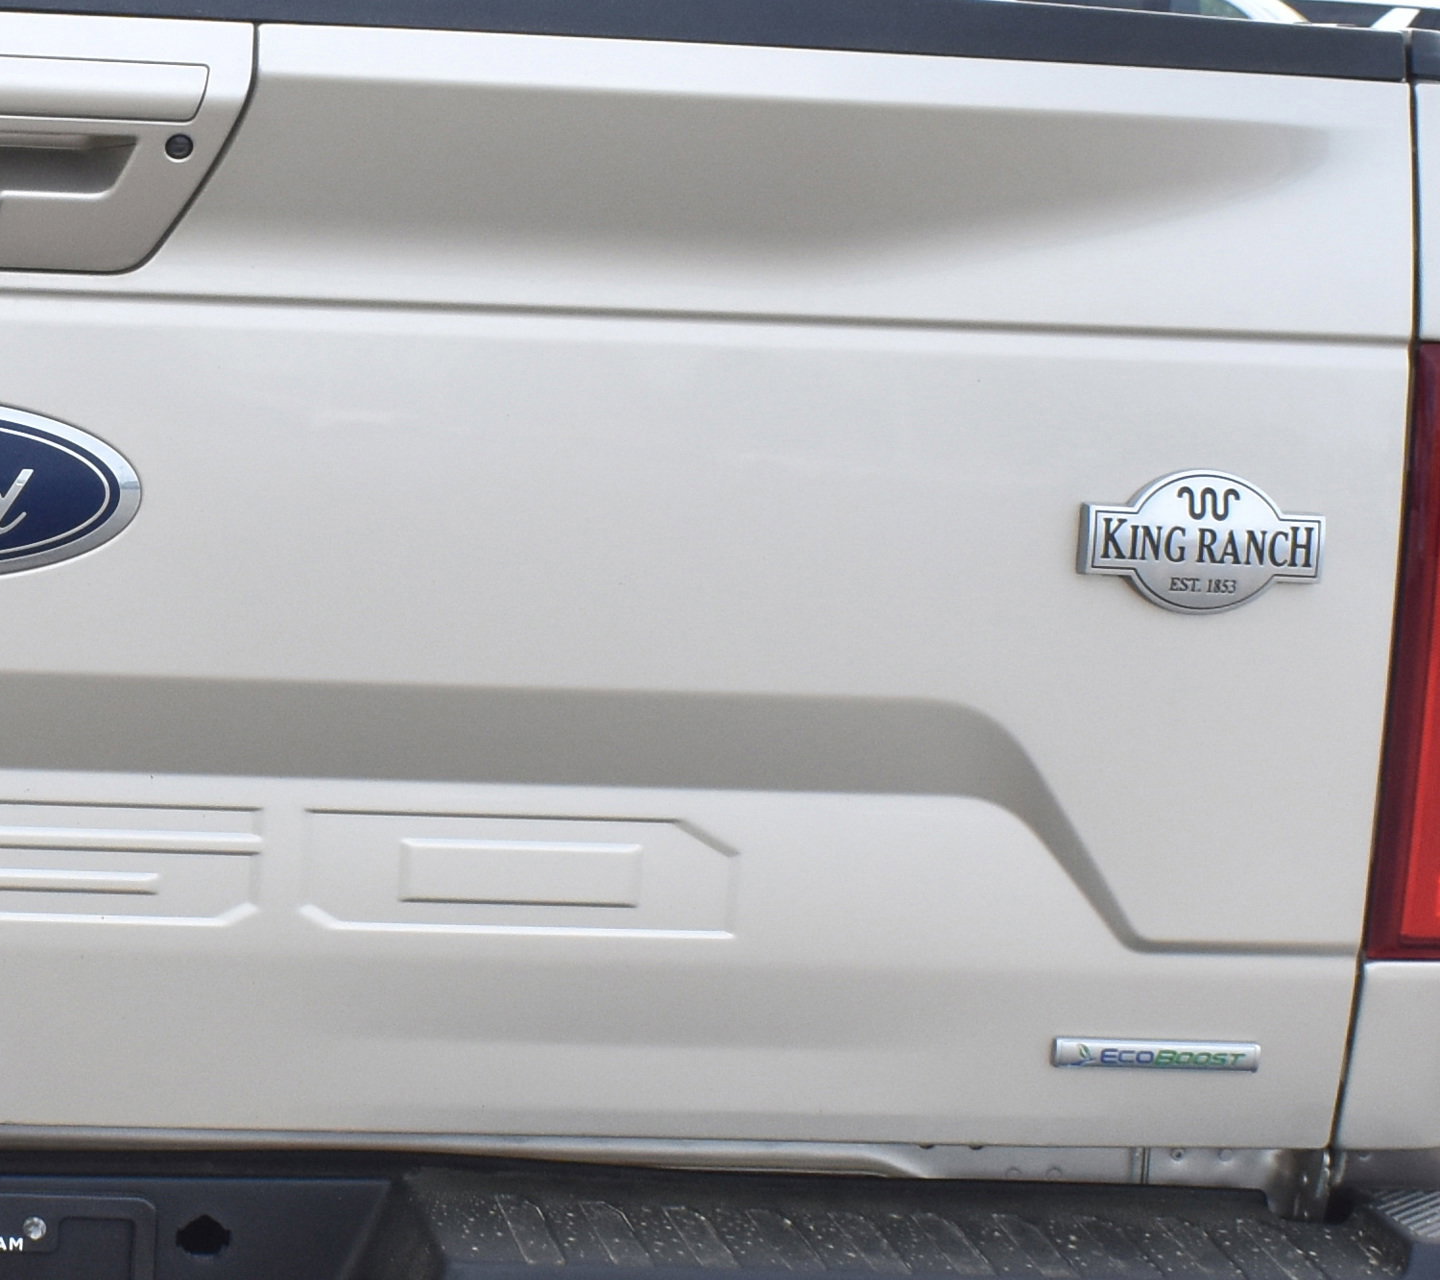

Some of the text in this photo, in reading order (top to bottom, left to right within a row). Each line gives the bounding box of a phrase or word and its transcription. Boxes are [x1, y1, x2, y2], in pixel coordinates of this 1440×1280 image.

[1100, 517, 1314, 568] KING RANCH
[1168, 577, 1237, 594] EST. 1853
